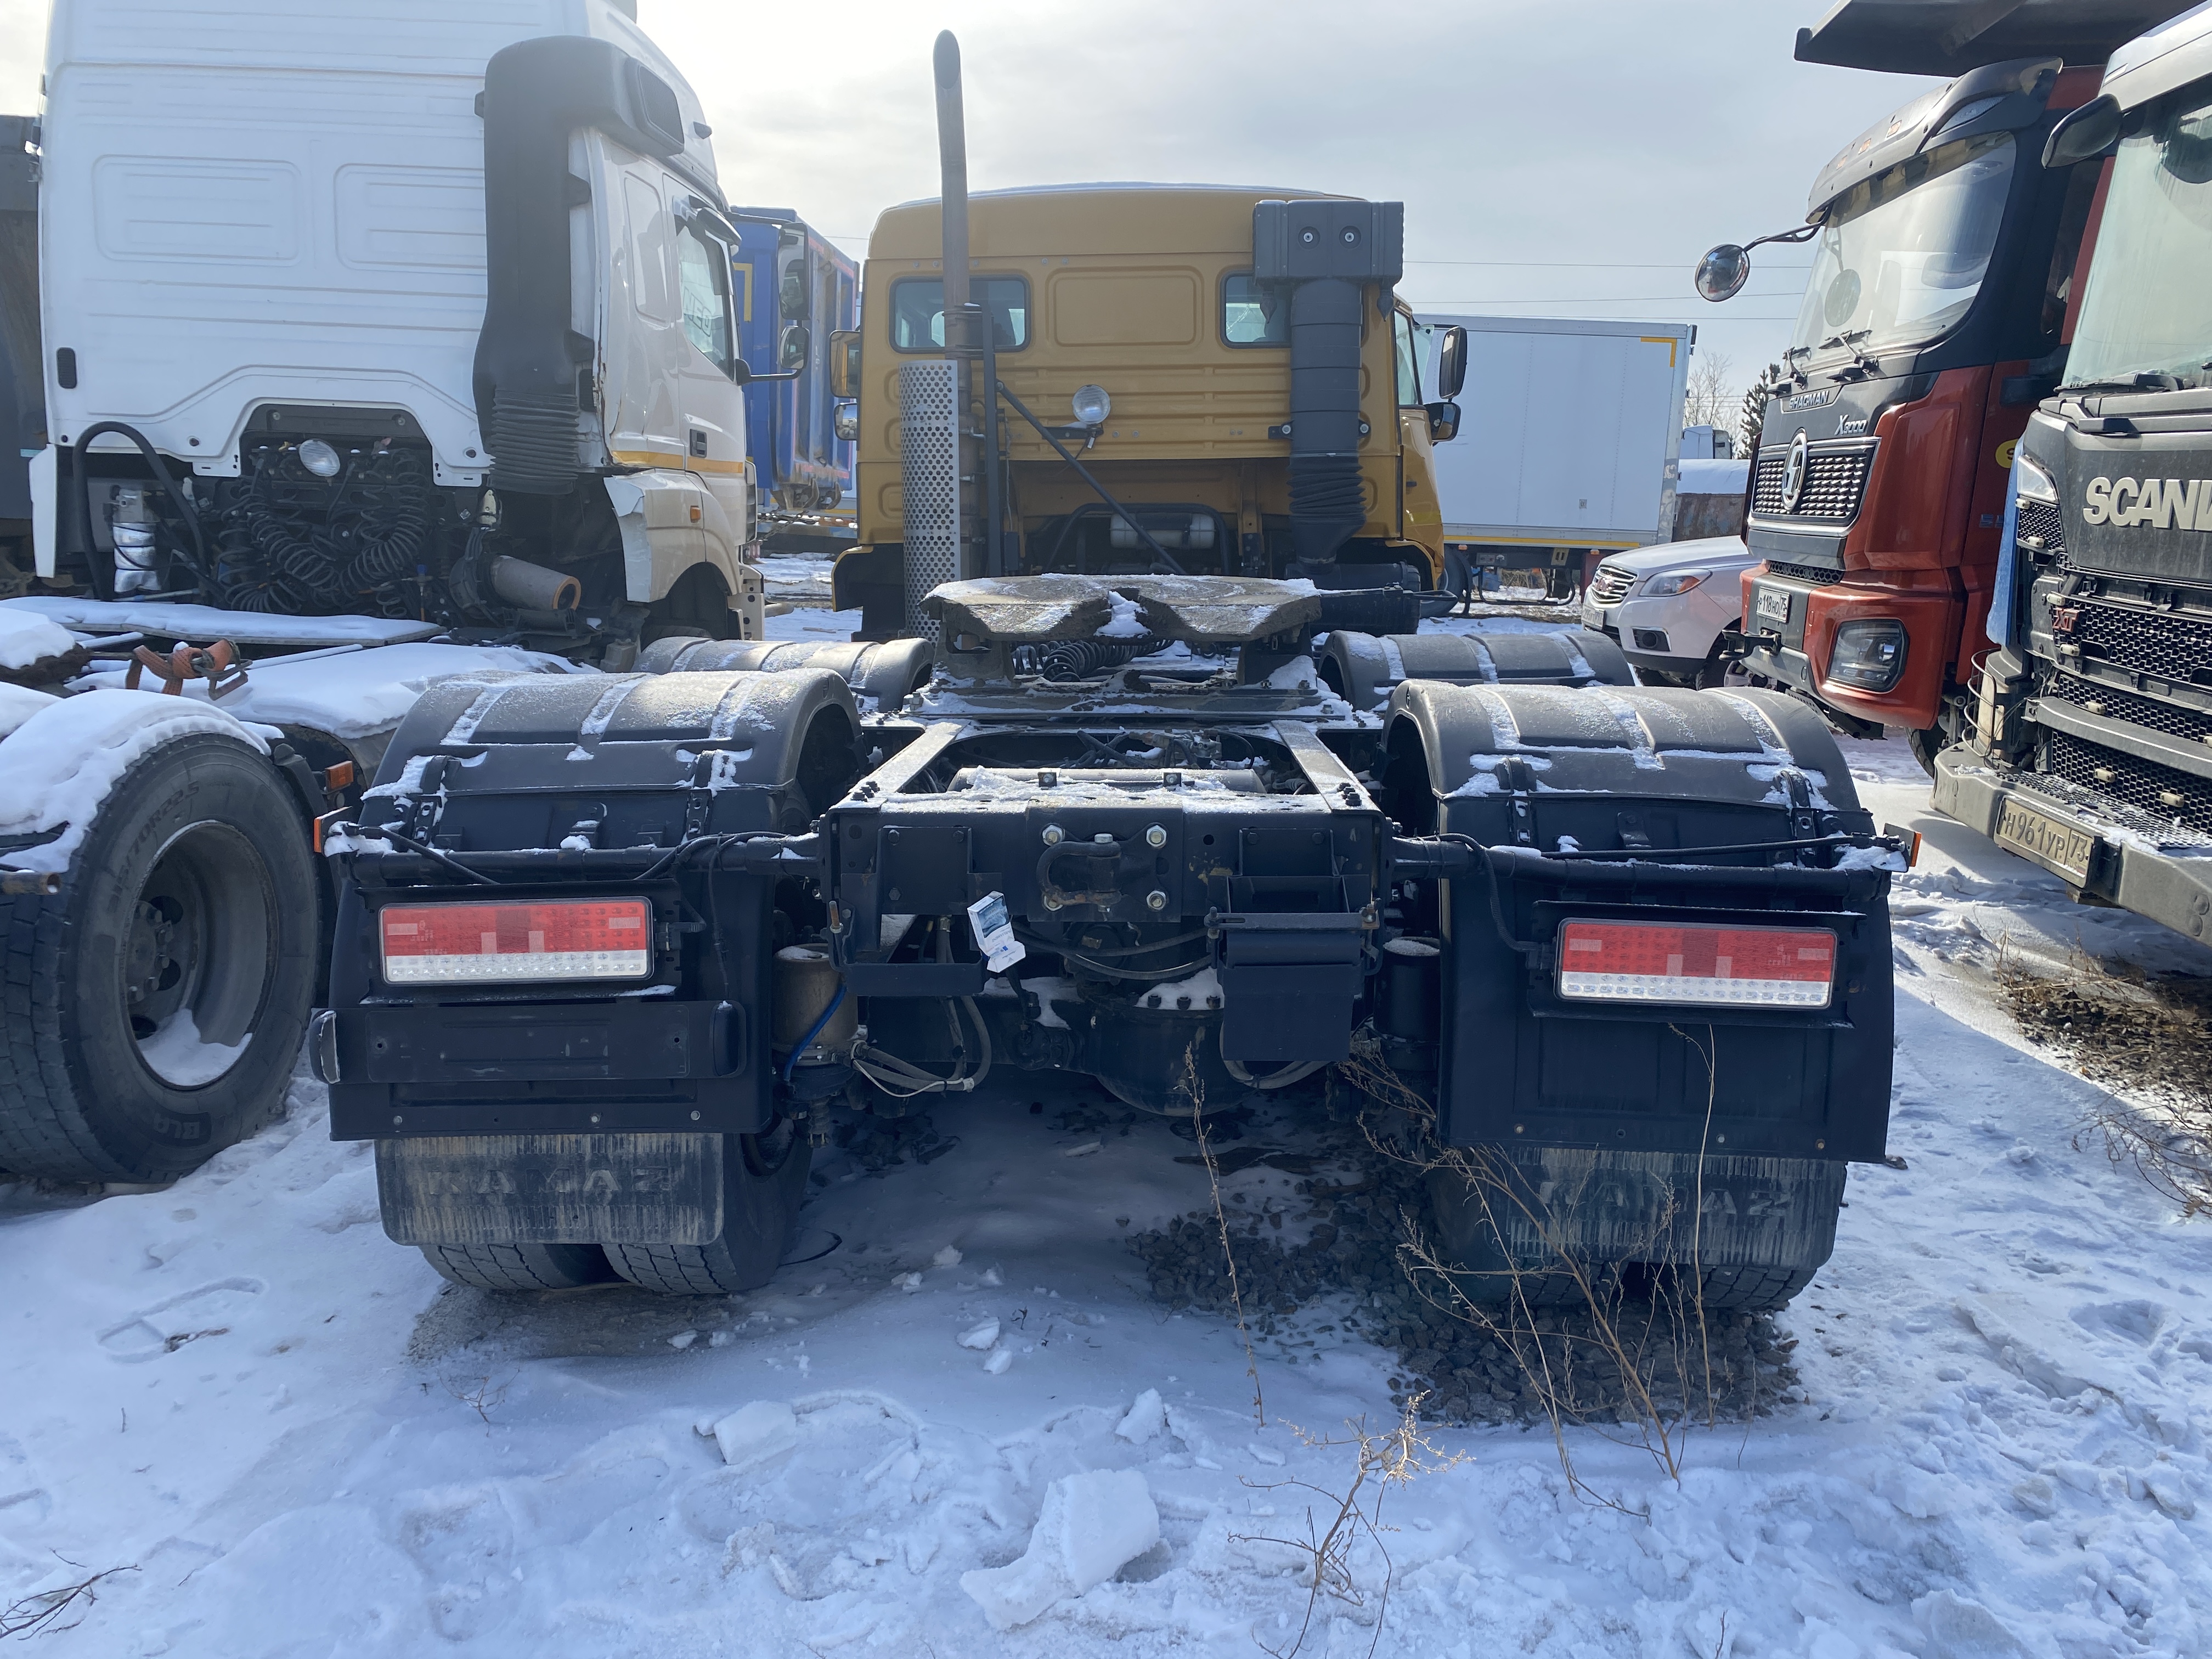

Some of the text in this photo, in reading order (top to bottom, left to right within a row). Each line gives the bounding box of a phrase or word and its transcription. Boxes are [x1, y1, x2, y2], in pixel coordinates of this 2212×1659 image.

[1789, 391, 1830, 410] SHACMAN
[1834, 414, 1868, 436] X3000
[2083, 476, 2212, 532] SCANI
[2052, 608, 2080, 633] XT
[2070, 833, 2088, 862] 73
[428, 1166, 670, 1195] KAMAZ
